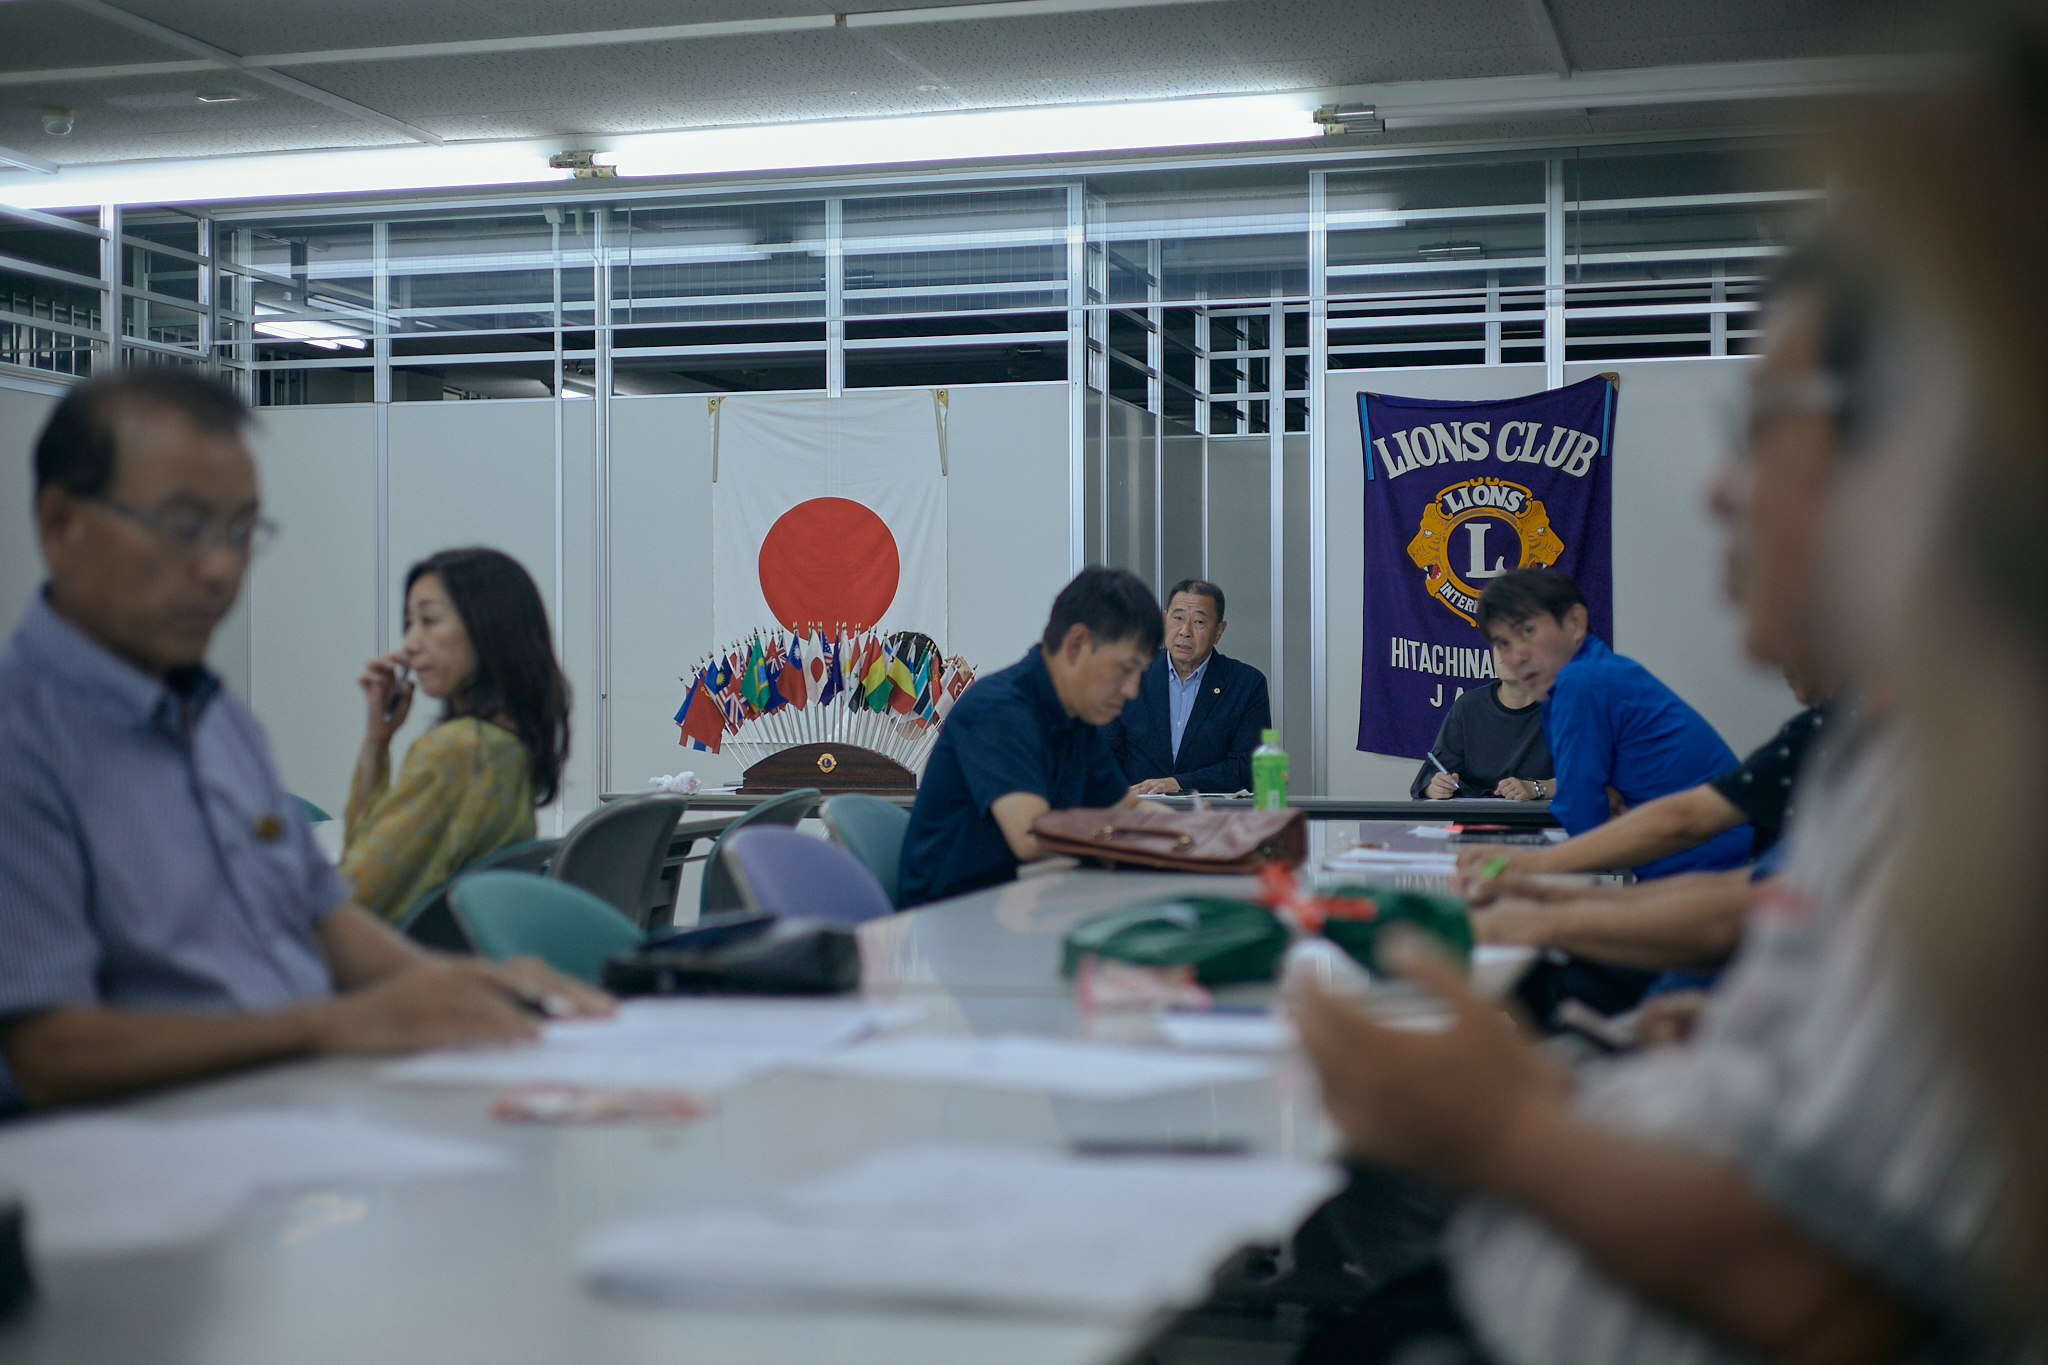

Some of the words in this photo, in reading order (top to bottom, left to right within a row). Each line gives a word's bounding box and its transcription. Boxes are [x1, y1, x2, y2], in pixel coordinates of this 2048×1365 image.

[1373, 421, 1490, 480] LIONS
[1496, 421, 1600, 477] CLUB
[1442, 485, 1526, 514] LIONS
[1465, 523, 1507, 578] L
[1391, 636, 1498, 679] HITACHINA
